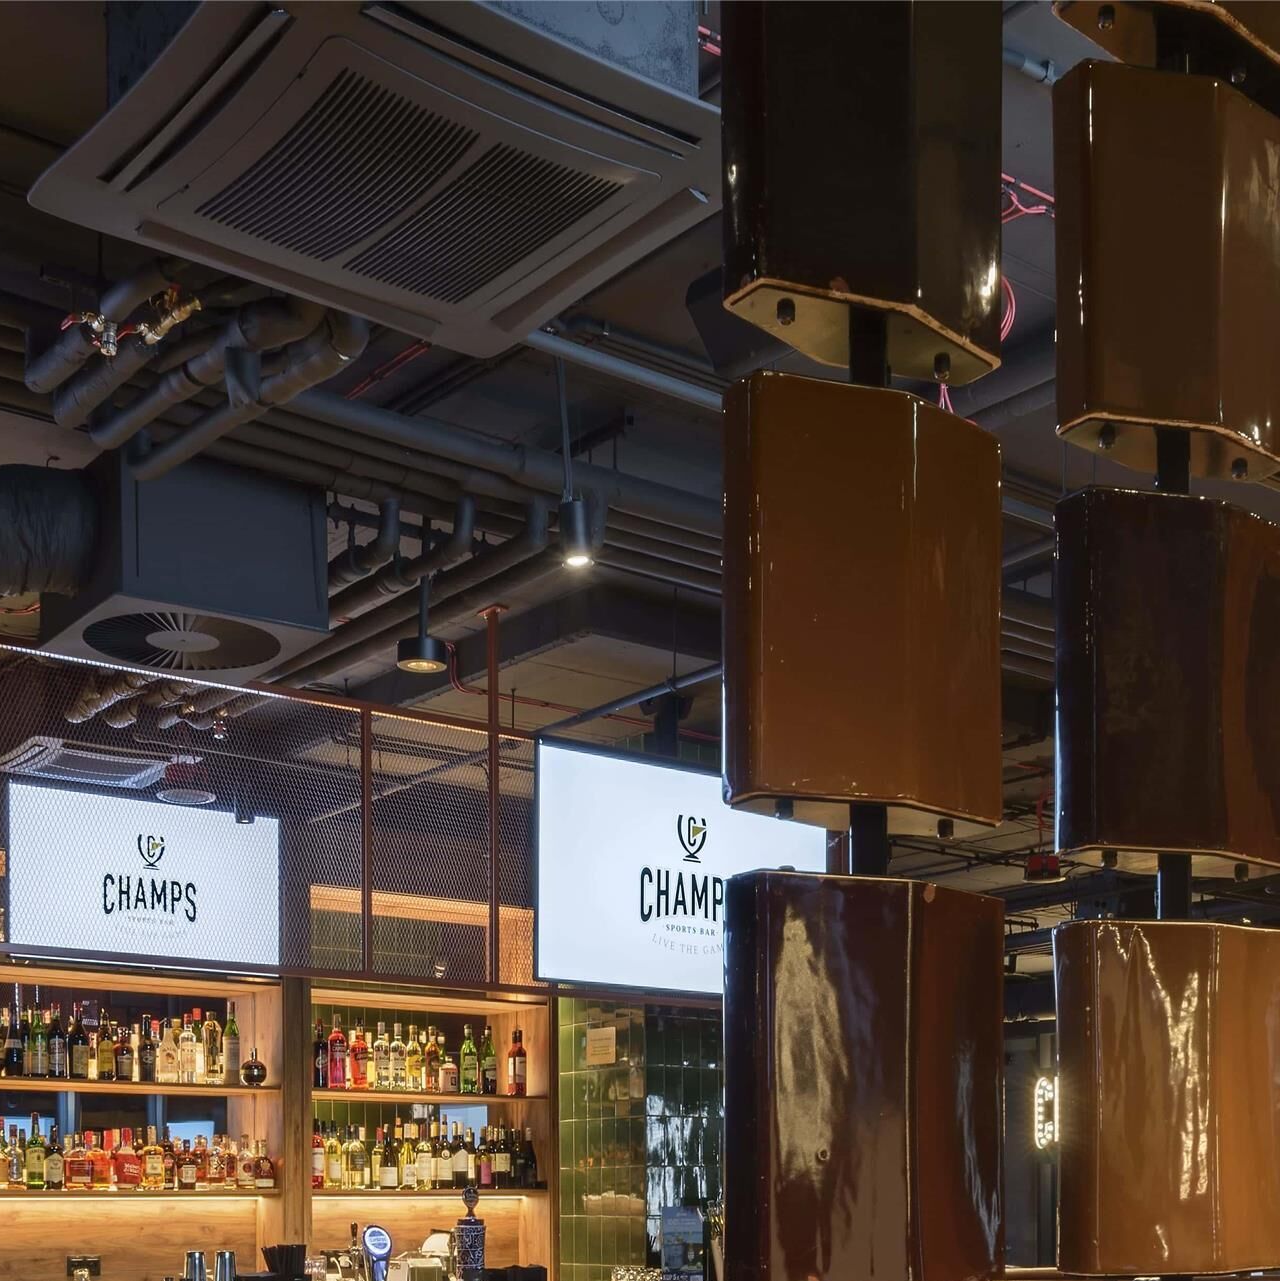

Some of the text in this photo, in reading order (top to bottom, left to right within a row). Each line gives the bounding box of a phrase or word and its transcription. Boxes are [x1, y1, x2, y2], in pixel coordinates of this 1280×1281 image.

[103, 873, 197, 923] CHAMPS
[640, 866, 724, 922] CHAMP
[665, 923, 716, 936] SPORTS BAR
[703, 943, 724, 955] GAM
